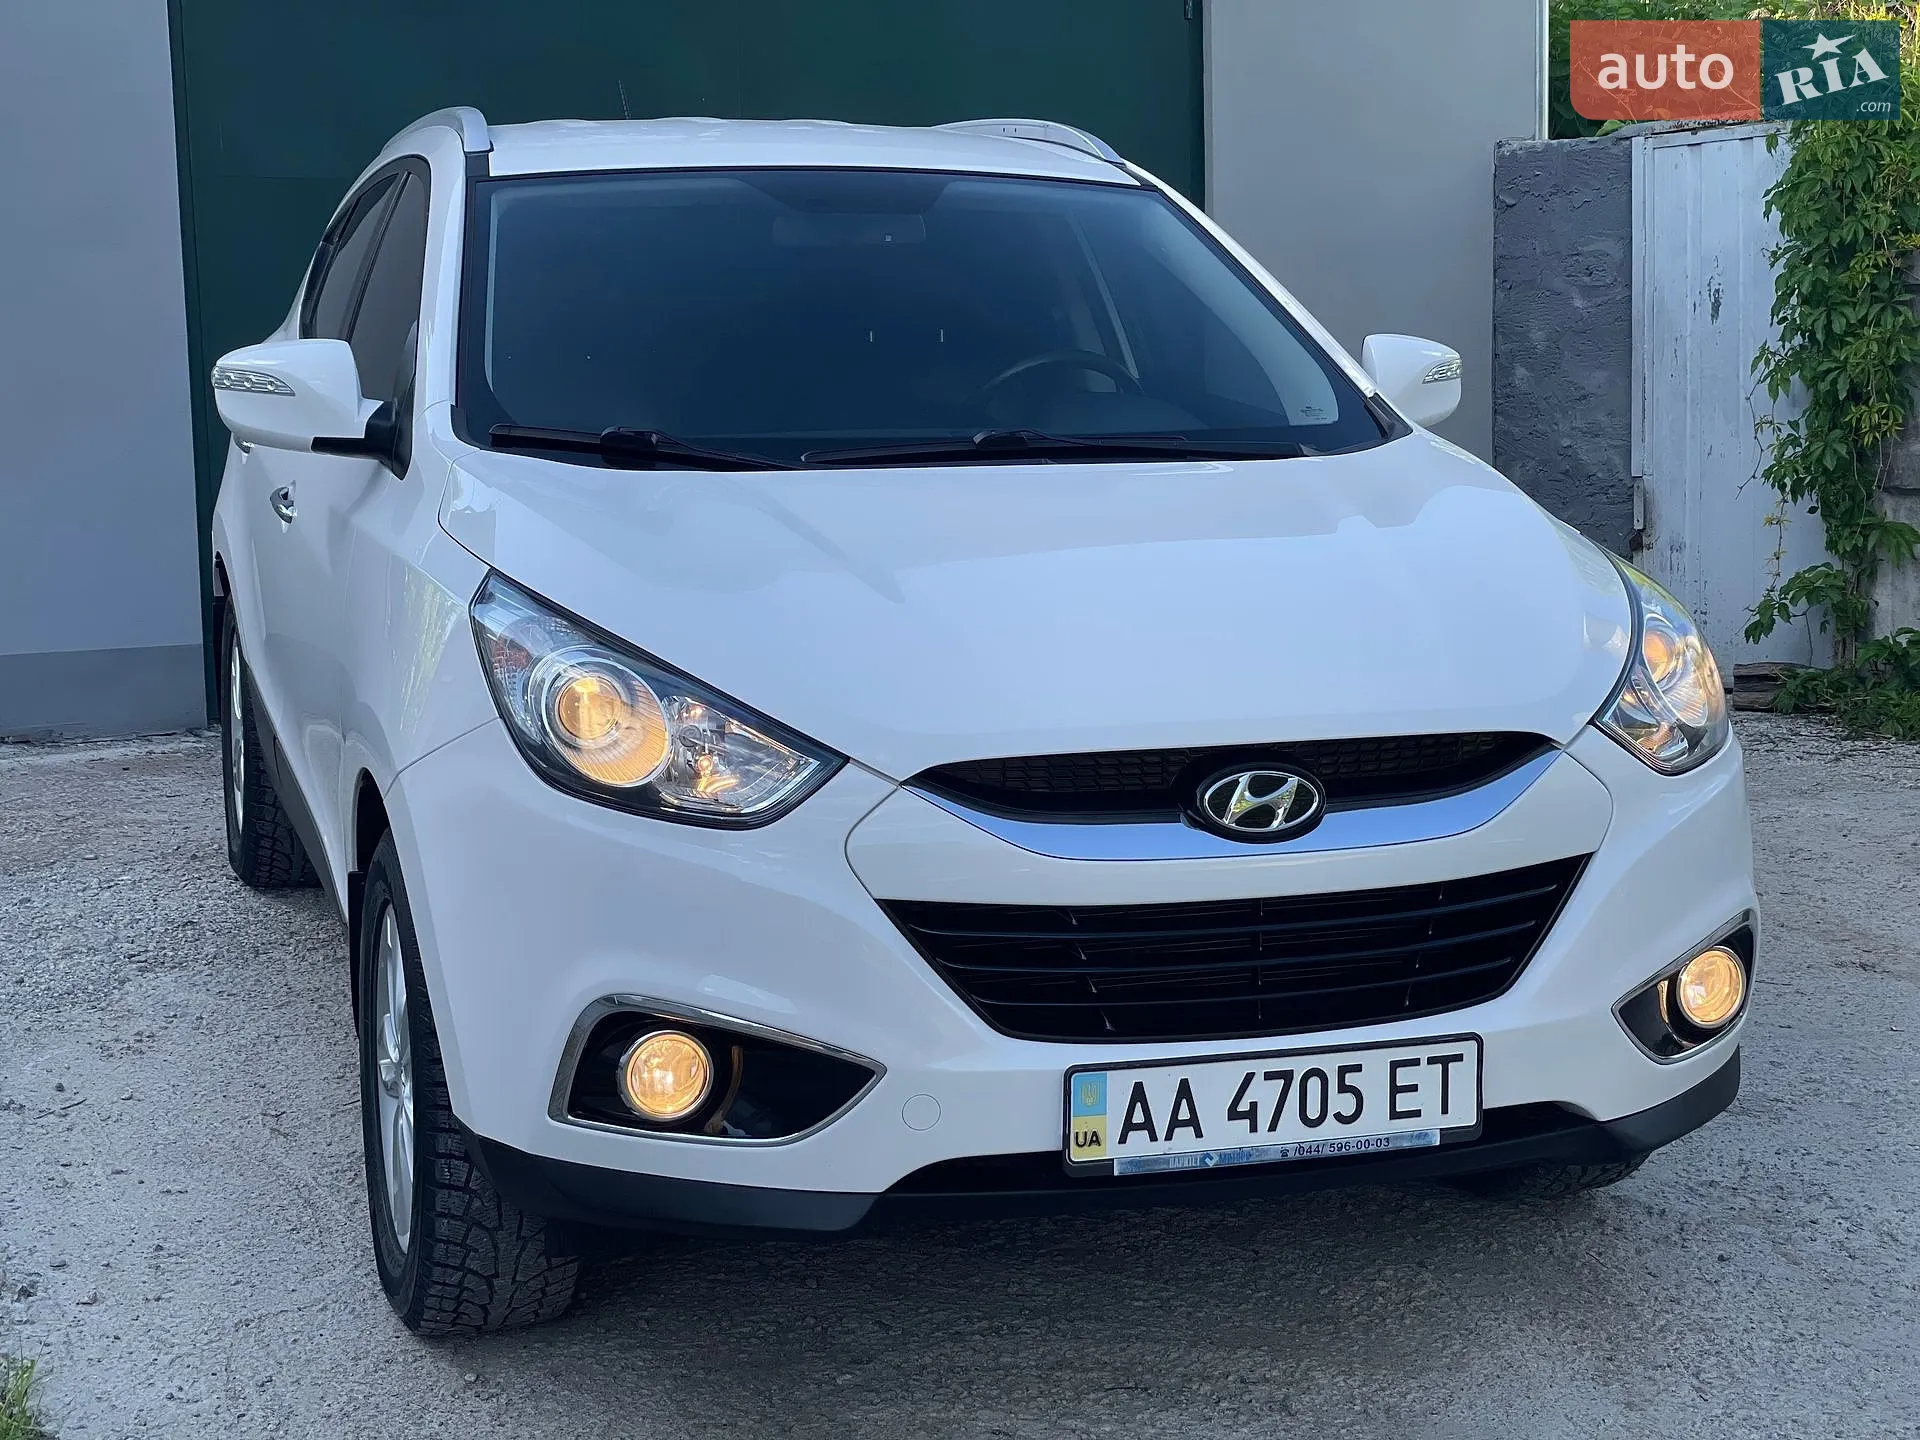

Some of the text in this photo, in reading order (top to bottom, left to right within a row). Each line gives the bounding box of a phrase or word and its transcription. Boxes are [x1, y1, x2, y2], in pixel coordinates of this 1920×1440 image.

[1117, 1053, 1465, 1145] AA 4705 ET
[1075, 1130, 1101, 1148] UA
